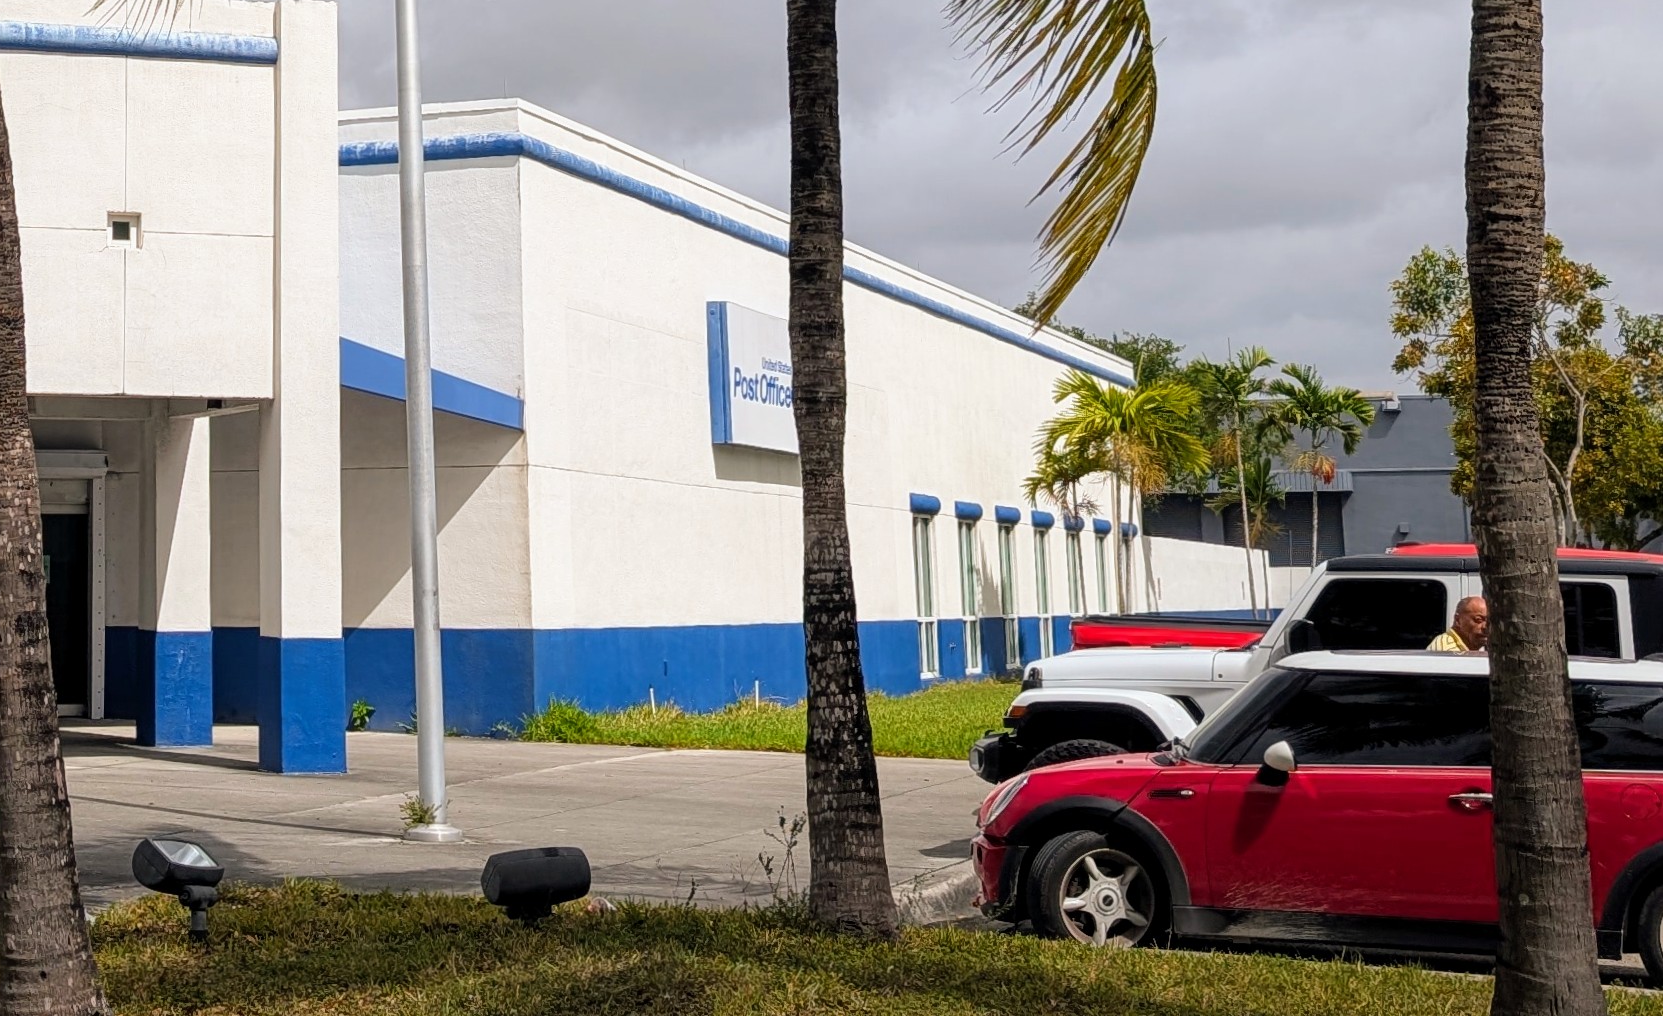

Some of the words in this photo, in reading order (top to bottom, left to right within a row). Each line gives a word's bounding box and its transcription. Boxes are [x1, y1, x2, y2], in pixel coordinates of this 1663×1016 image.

[762, 357, 777, 372] United
[734, 367, 759, 402] Post
[760, 374, 792, 408] Office
